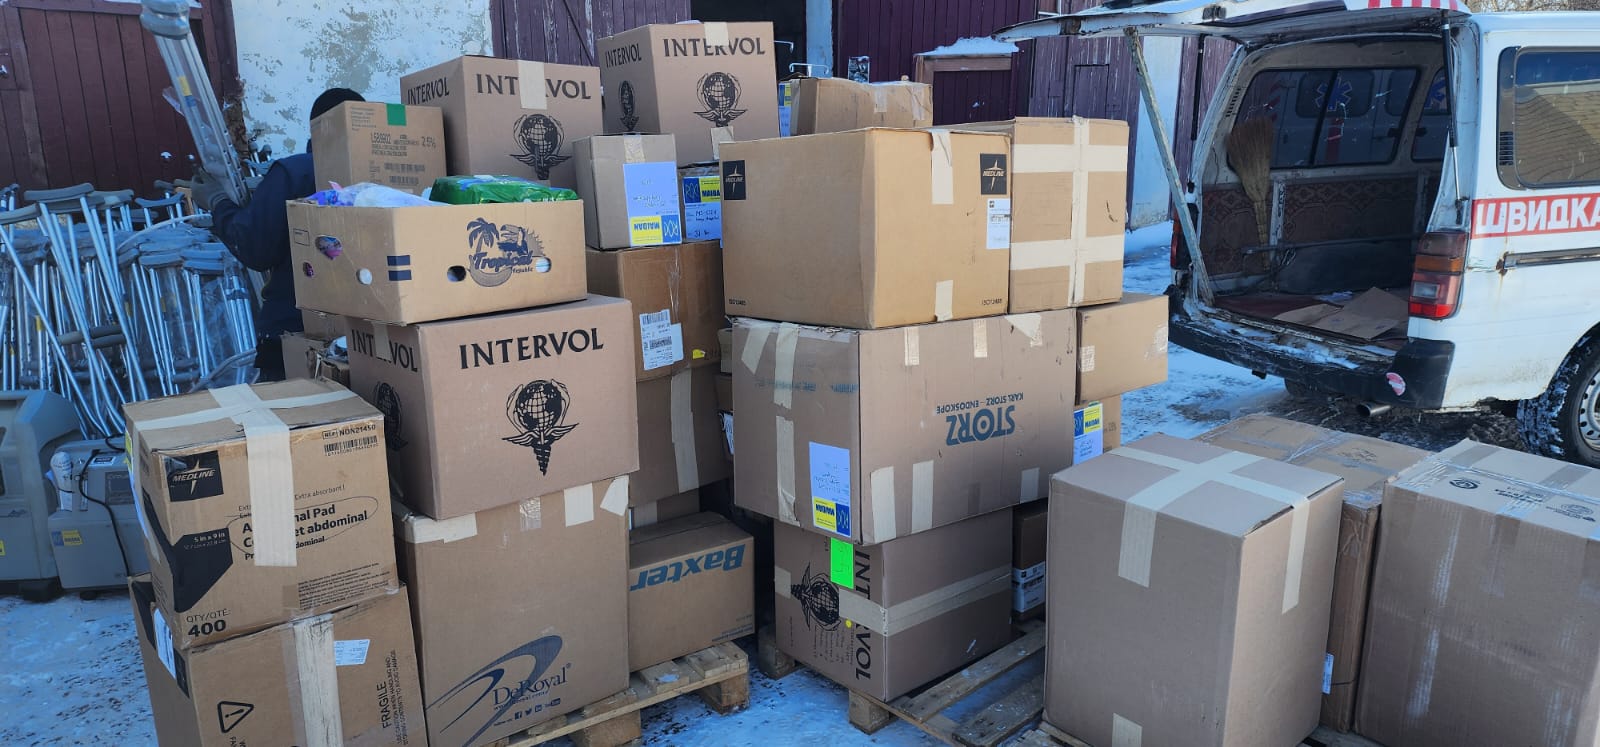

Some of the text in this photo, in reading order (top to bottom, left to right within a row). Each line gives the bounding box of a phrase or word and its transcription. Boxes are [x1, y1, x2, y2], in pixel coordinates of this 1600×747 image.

[605, 43, 642, 68] INTERVOL
[407, 77, 450, 104] INTERVOL
[476, 73, 591, 100] INTVOL
[634, 222, 659, 230] MAIDAN
[473, 250, 533, 272] Tropical
[351, 330, 418, 373] INTVOL
[459, 327, 604, 369] INTERVOL
[936, 400, 980, 414] ENDOSKOPE
[986, 395, 1007, 406] STORZ
[1008, 392, 1024, 402] KARL
[946, 405, 1015, 446] STORZ
[172, 469, 216, 482] MEDLINE
[307, 510, 368, 534] abdominal
[313, 504, 336, 518] Pad
[295, 536, 325, 549] dominal
[630, 544, 745, 592] Baxter
[855, 550, 871, 680] INTVOL
[188, 619, 226, 638] 400
[376, 681, 392, 729] FRAGILE
